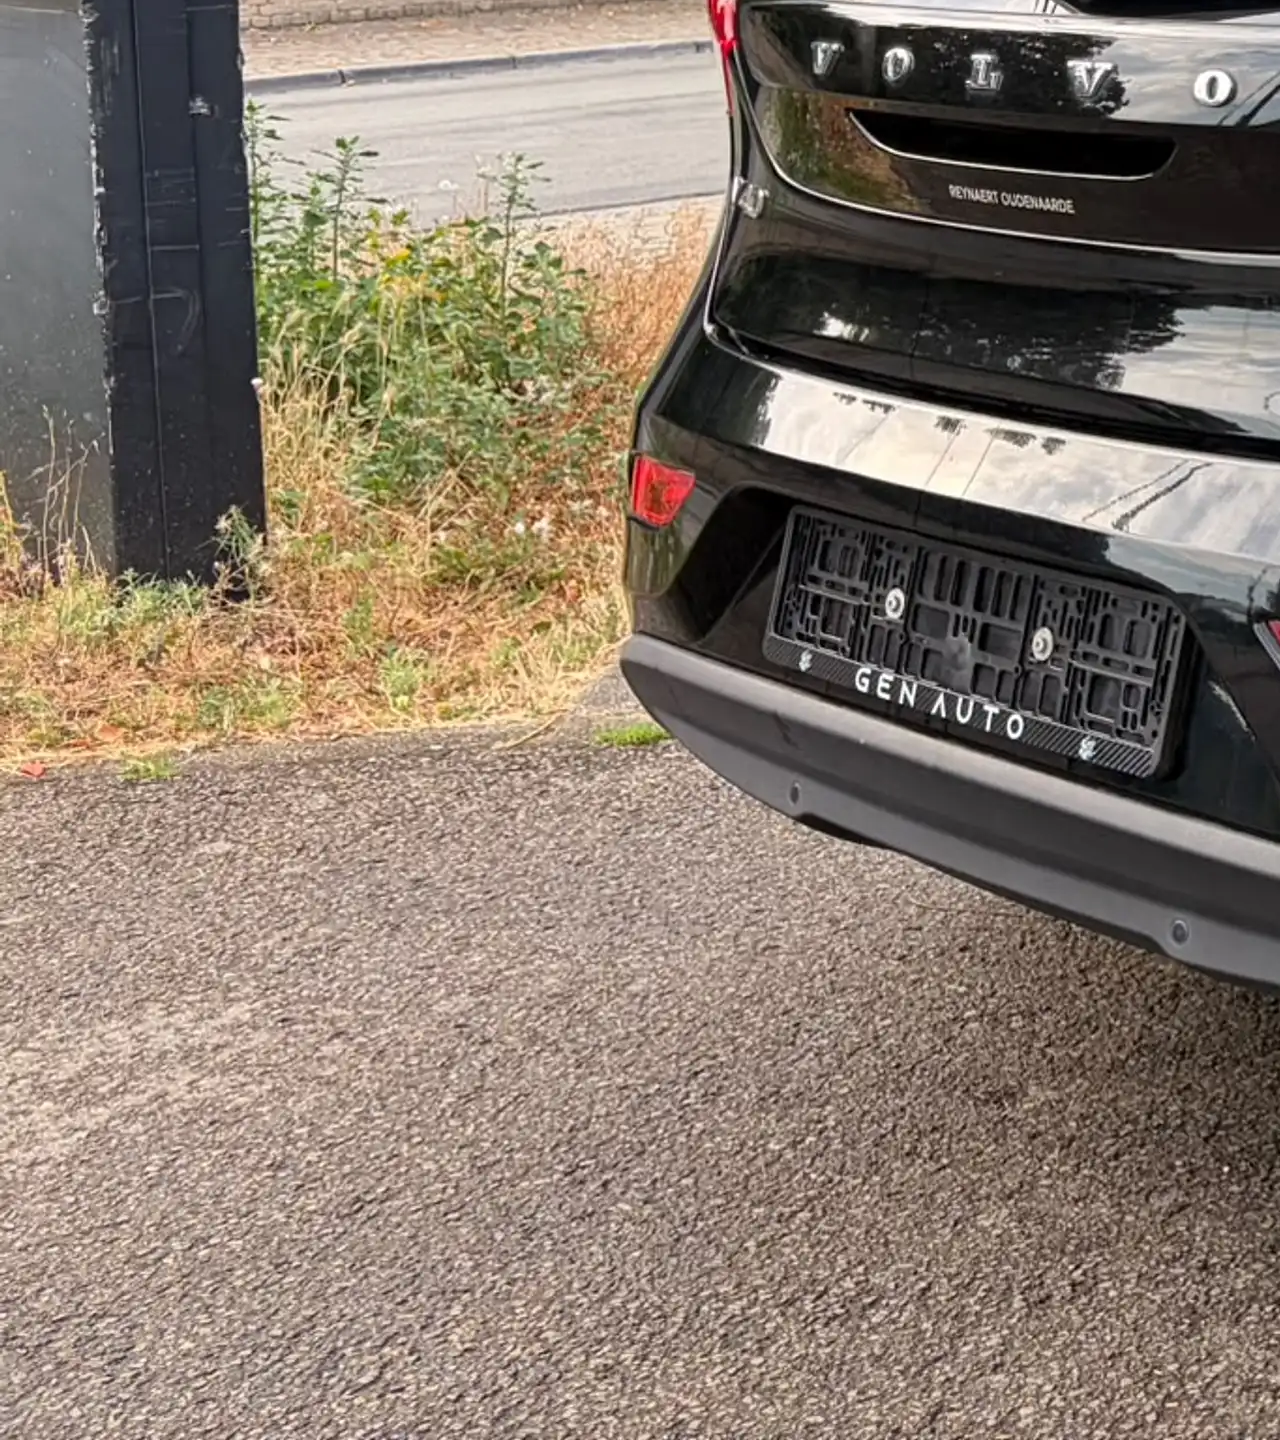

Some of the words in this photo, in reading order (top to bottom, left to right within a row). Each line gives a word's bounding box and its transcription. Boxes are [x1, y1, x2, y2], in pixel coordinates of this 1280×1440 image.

[810, 40, 1240, 109] VOLVO
[948, 183, 999, 205] REYNAERT
[1000, 191, 1076, 214] OUDENAARDE
[854, 666, 919, 709] GEN
[930, 693, 1025, 740] AUTO
